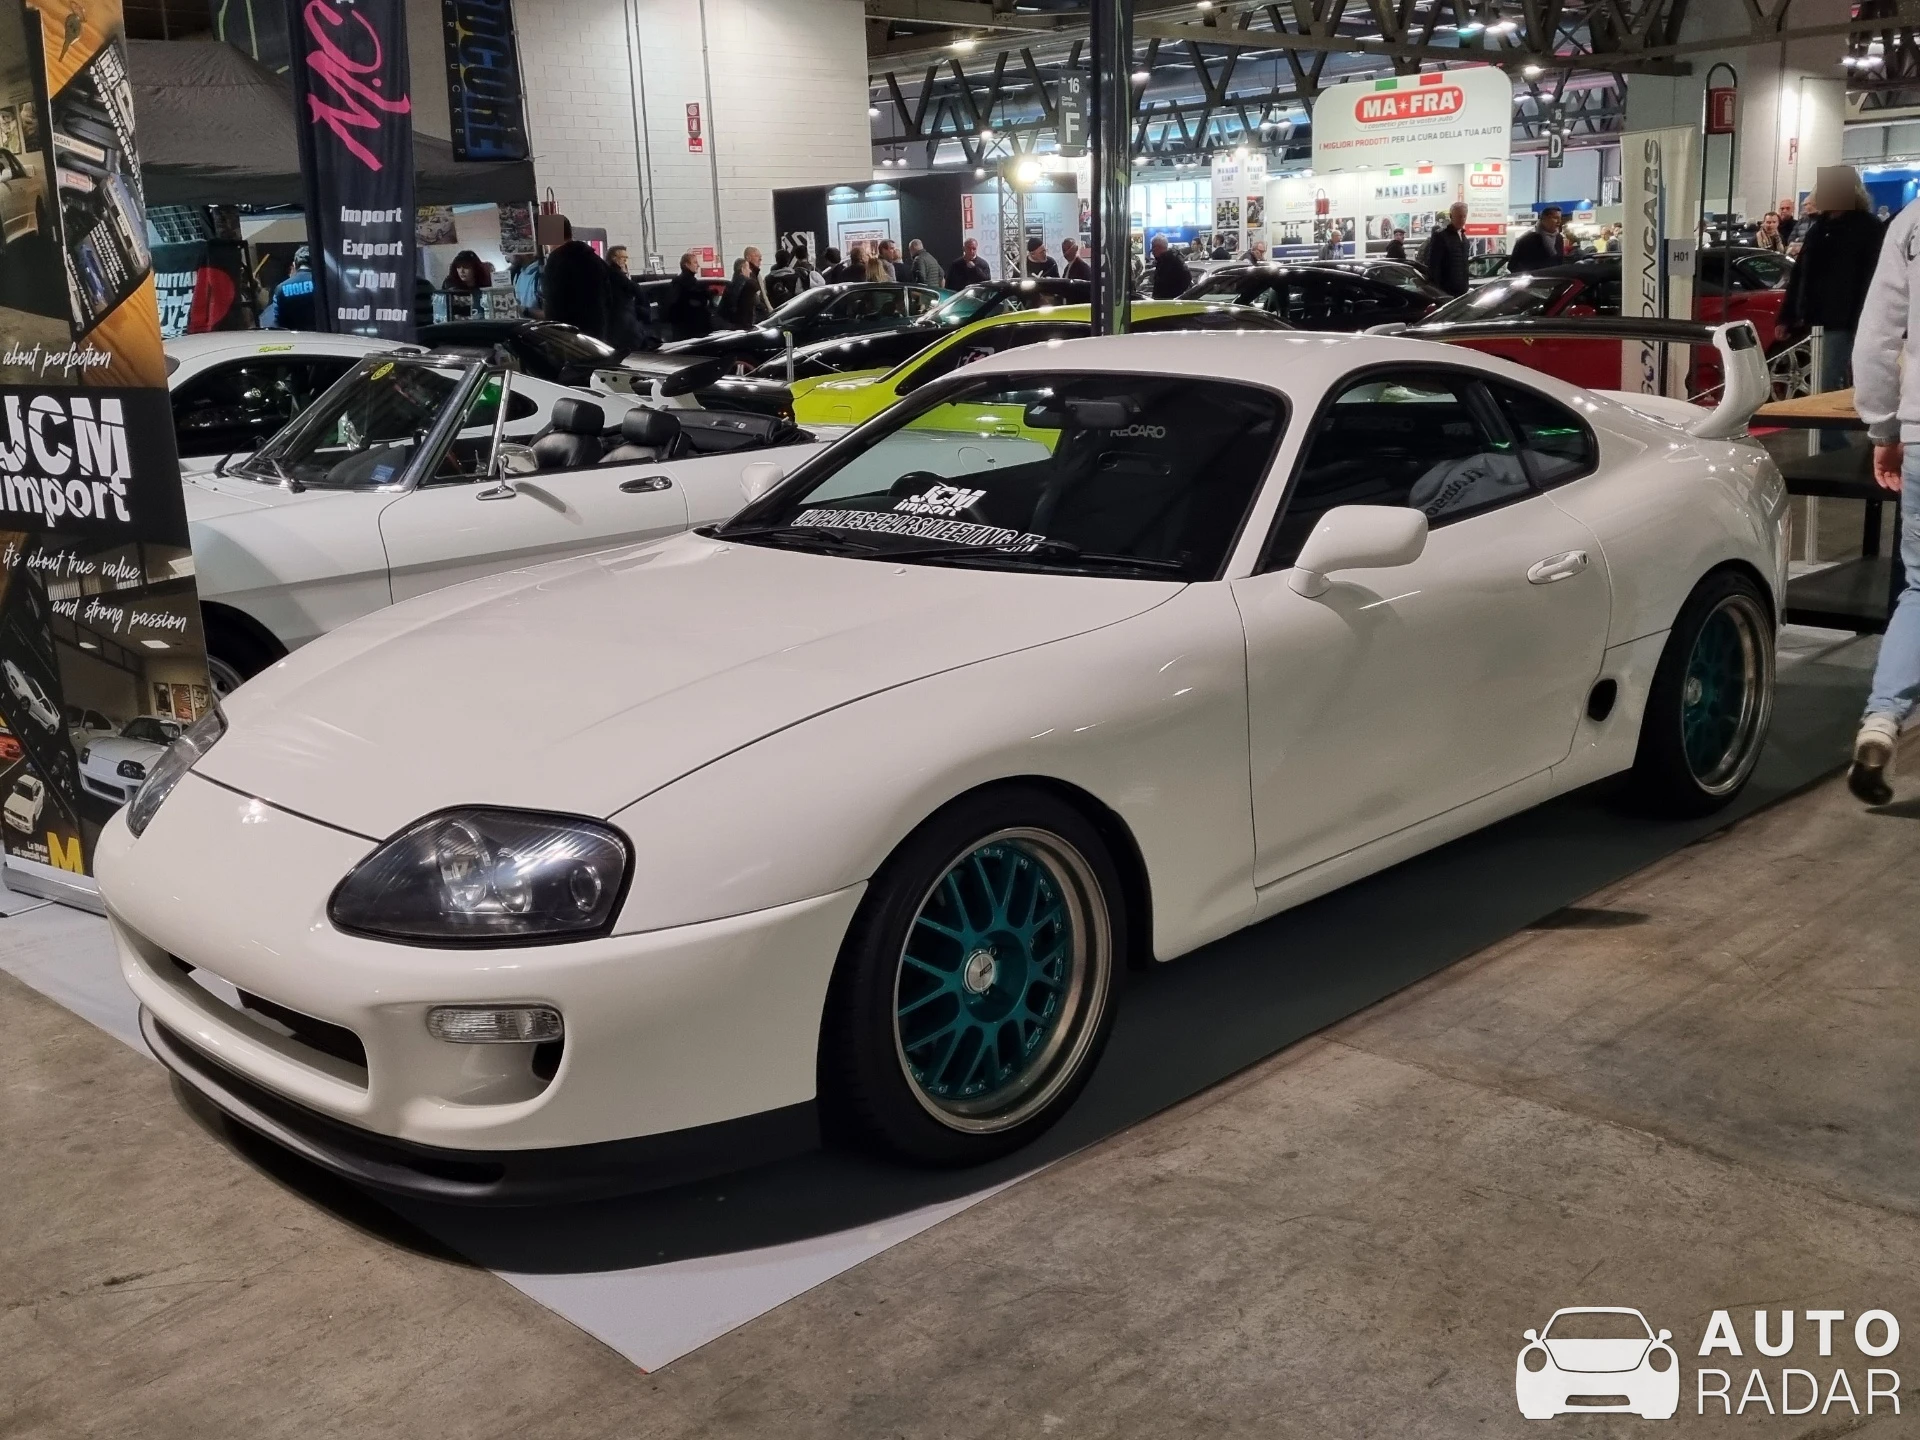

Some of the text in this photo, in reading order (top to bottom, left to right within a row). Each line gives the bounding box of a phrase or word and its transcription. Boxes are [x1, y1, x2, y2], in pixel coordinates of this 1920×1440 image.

[1068, 77, 1080, 94] 16
[1065, 112, 1080, 144] F
[1397, 119, 1409, 128] per
[1437, 115, 1454, 123] auto
[1323, 139, 1354, 150] MIGLIORI
[1355, 136, 1390, 148] PRODOTTI
[1391, 135, 1405, 144] PER
[1407, 134, 1416, 142] LA
[1417, 131, 1438, 141] CURA
[1440, 129, 1463, 139] DELLA
[1465, 128, 1480, 137] TUA
[1481, 126, 1502, 136] AUTO
[1551, 135, 1562, 158] D
[1375, 182, 1446, 198] MANIAC LINE
[341, 205, 402, 226] Import
[342, 238, 403, 260] Export
[1673, 251, 1690, 262] H01
[356, 270, 396, 289] JDM
[338, 304, 371, 321] and
[3, 342, 112, 378] about perfection
[0, 395, 132, 479] JCM
[1110, 424, 1166, 439] RECARO
[893, 498, 962, 516] import
[909, 485, 987, 508] JCM
[27, 547, 65, 577] about
[67, 551, 97, 578] true
[102, 556, 141, 582] value
[52, 597, 188, 634] and strong passion
[47, 831, 84, 875] M
